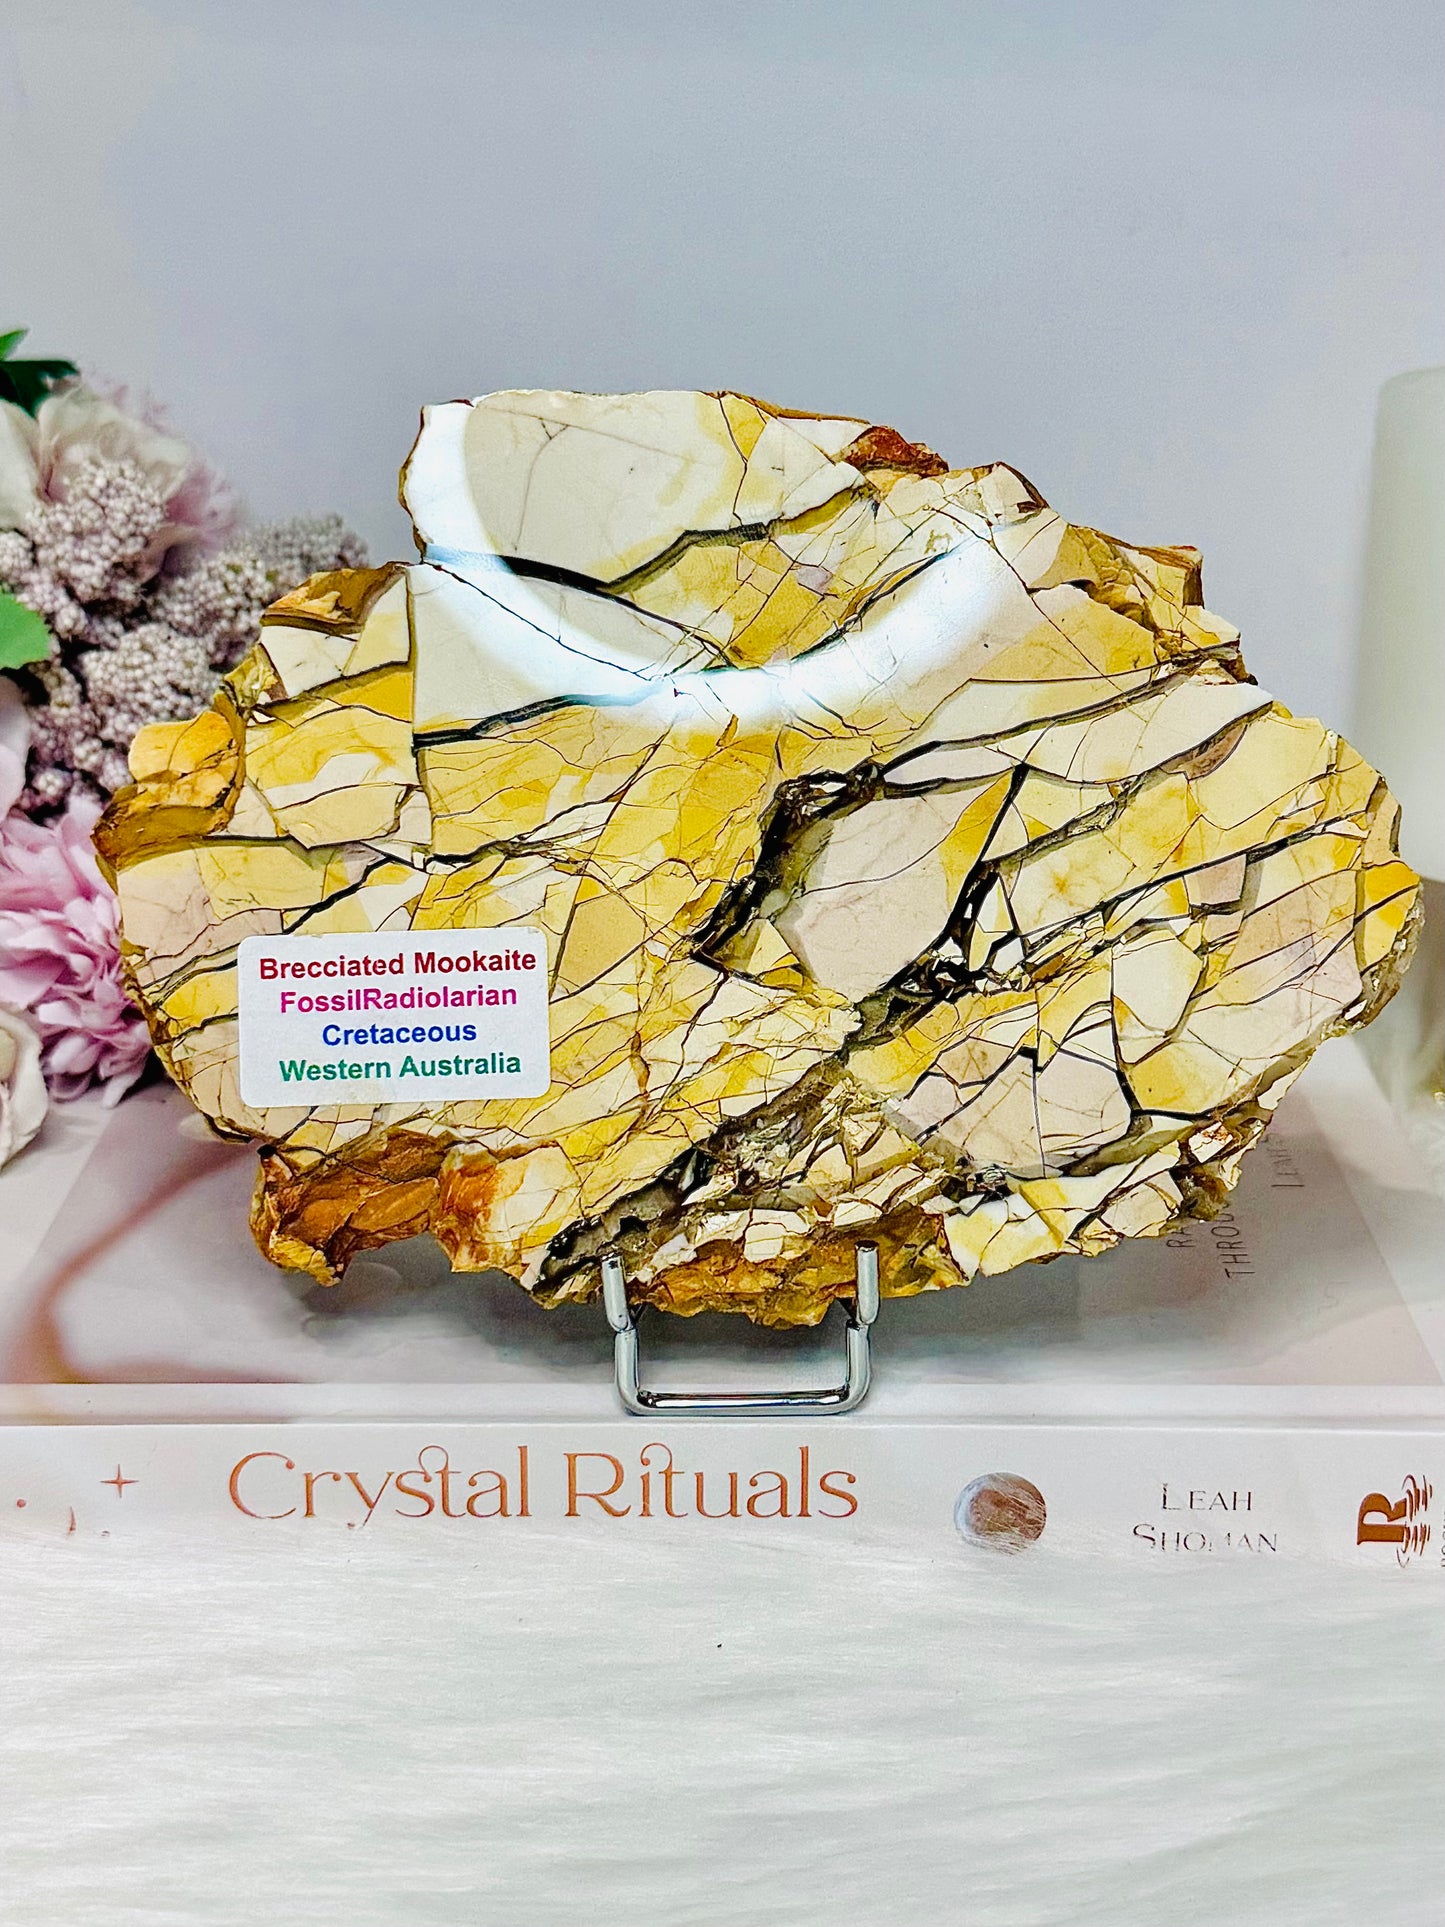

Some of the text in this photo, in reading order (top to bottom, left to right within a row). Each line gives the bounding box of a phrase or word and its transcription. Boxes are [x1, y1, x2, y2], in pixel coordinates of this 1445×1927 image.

[259, 949, 537, 980] Brecciated Mookaite
[280, 984, 517, 1014] FossilRadiolarian
[322, 1023, 477, 1047] Cretaceous
[279, 1052, 522, 1082] Western Australia
[1211, 1202, 1255, 1279] THROU
[228, 1442, 859, 1529] Crystal Rituals
[1162, 1483, 1252, 1511] LEAH
